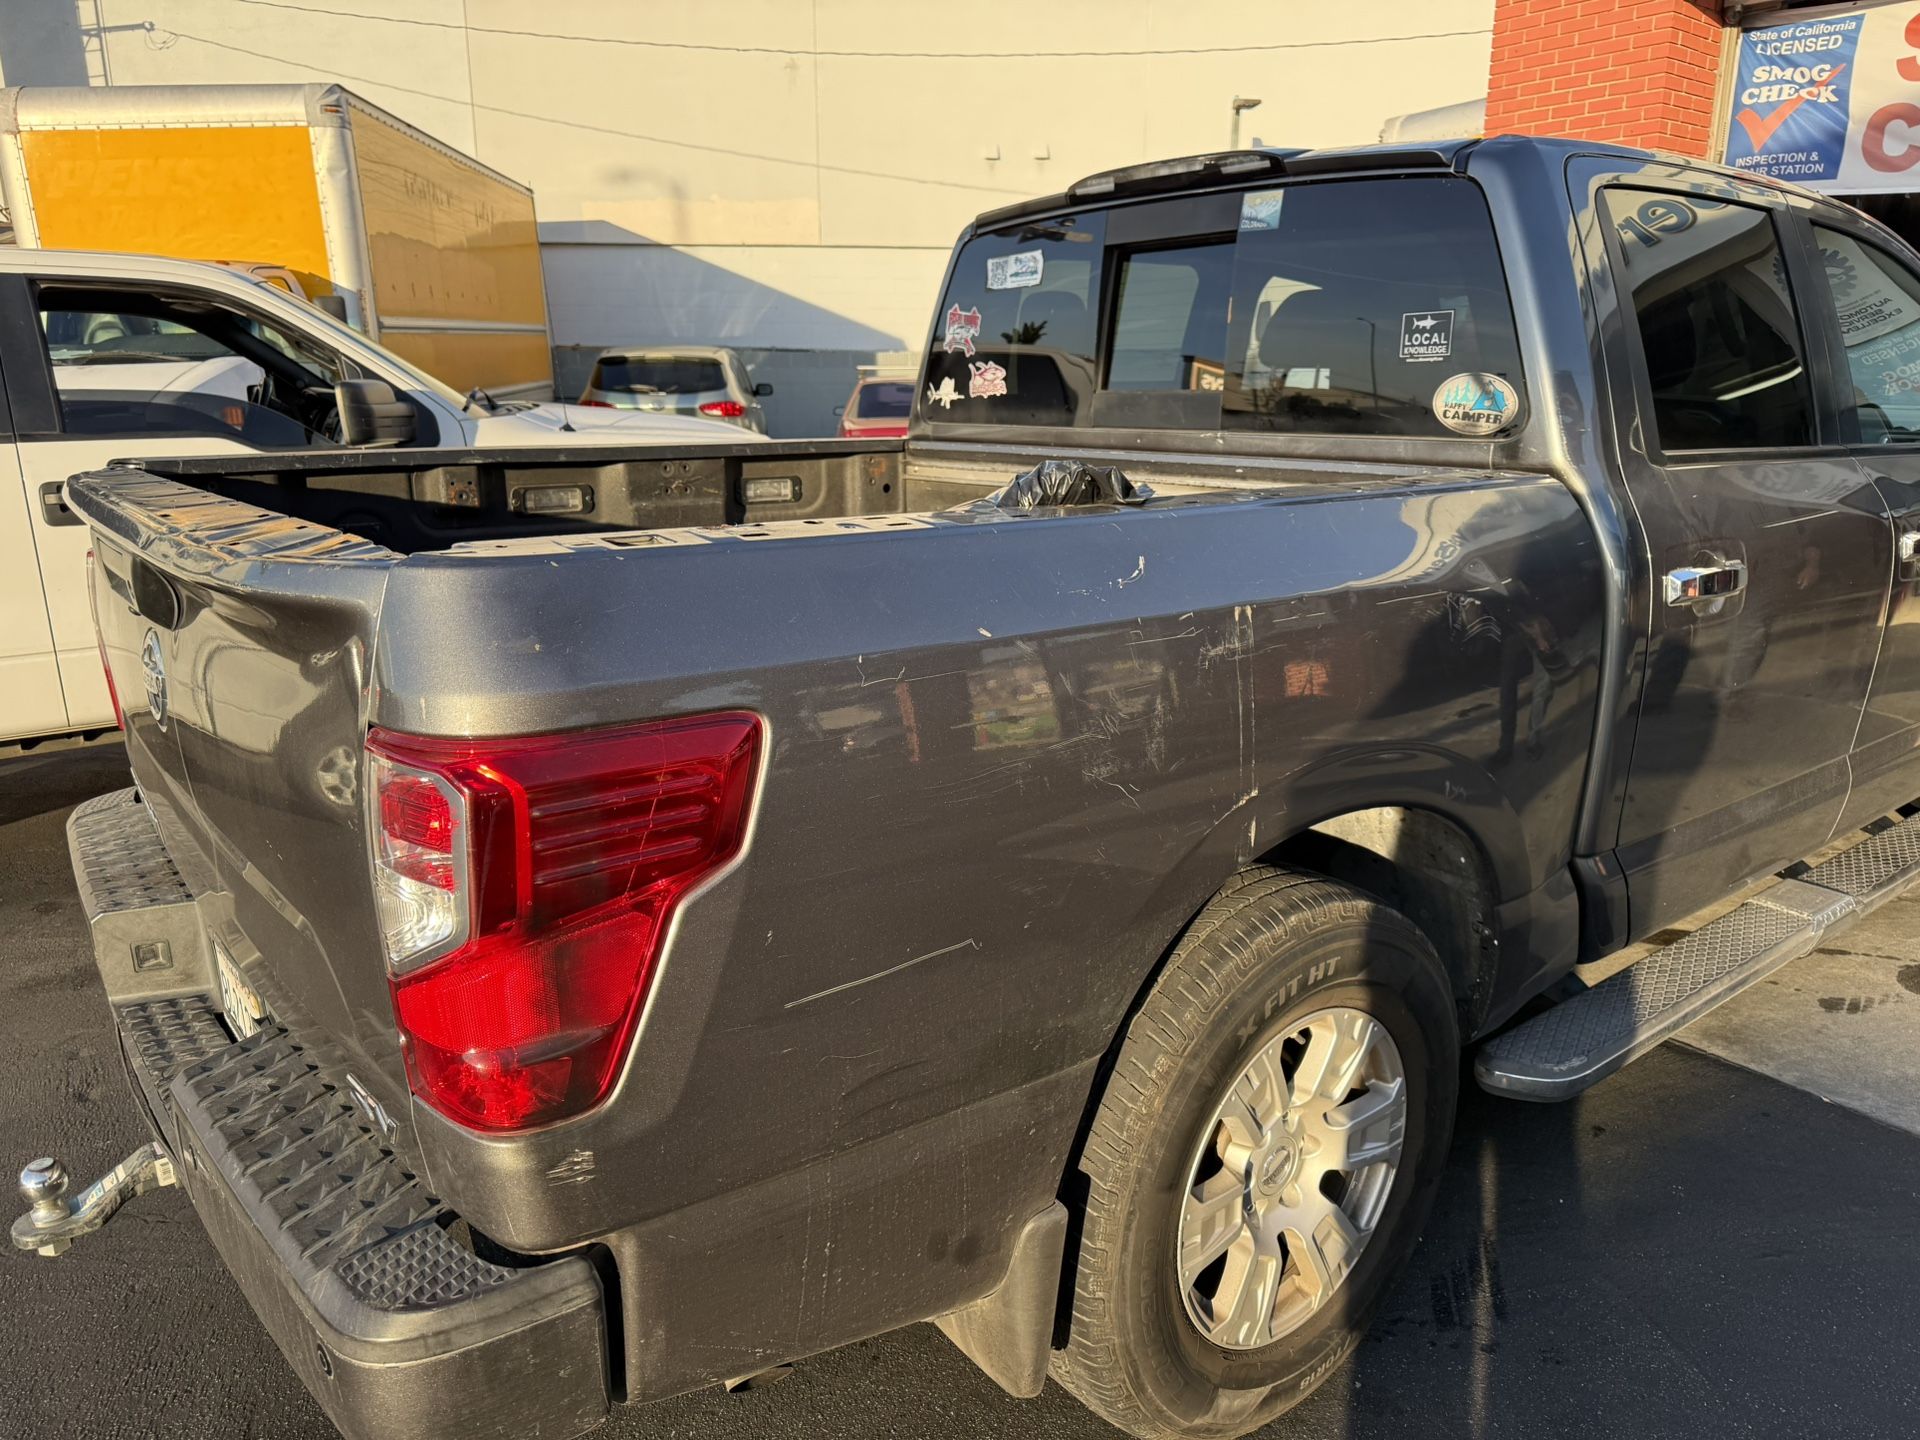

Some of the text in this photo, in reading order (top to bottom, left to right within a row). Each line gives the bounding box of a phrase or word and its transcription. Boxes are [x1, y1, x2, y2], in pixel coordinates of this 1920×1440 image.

[1749, 20, 1857, 41] State of California
[1756, 35, 1843, 56] LICENSED
[1752, 63, 1832, 83] SMOG
[1741, 83, 1839, 105] CHECK
[1735, 151, 1819, 168] INSPECTION &
[1771, 163, 1824, 176] STATION
[1404, 332, 1448, 346] LOCAL
[1404, 345, 1447, 355] KNOWLEDGE
[1442, 409, 1504, 425] CAMPER
[1264, 974, 1303, 1020] FIT
[1307, 956, 1341, 986] HT
